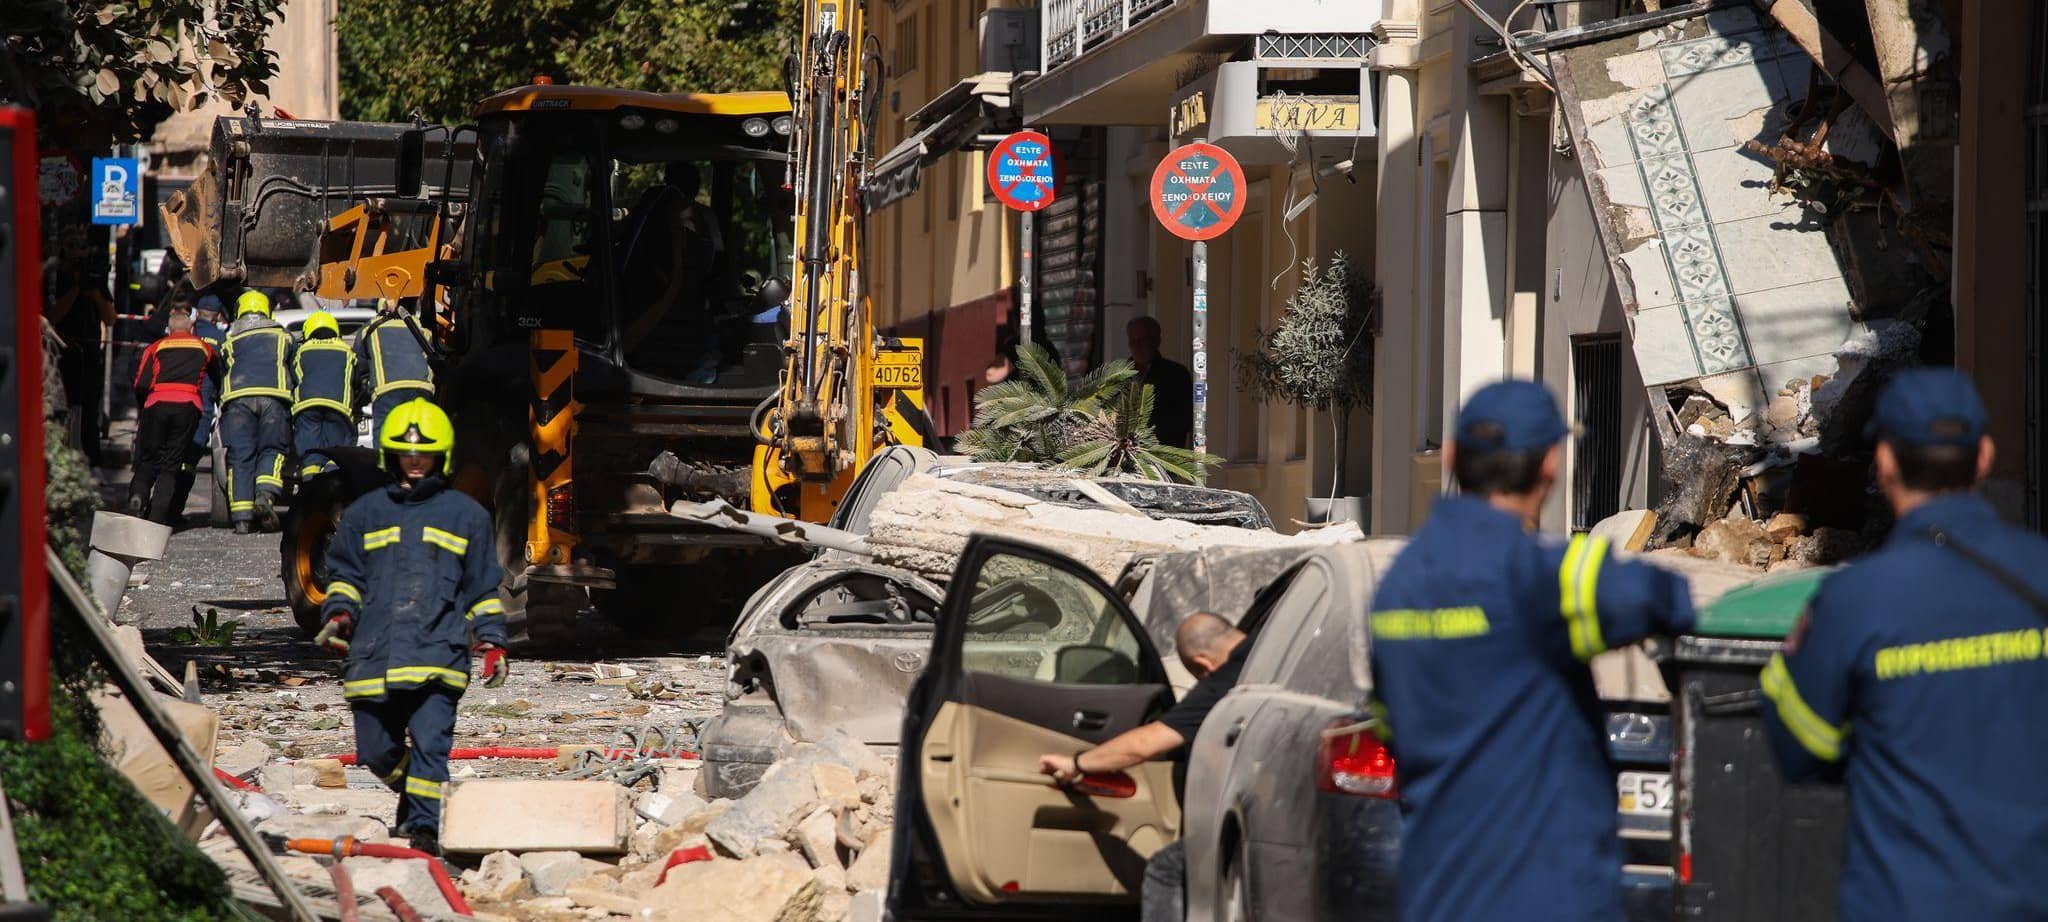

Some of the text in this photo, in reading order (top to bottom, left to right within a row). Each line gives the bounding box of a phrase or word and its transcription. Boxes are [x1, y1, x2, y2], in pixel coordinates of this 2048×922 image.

[1007, 158, 1049, 167] ΟΧΗΜΑΤΑ
[1170, 175, 1217, 185] ΟΧΗΜΑΤΑ
[875, 367, 920, 383] 40762
